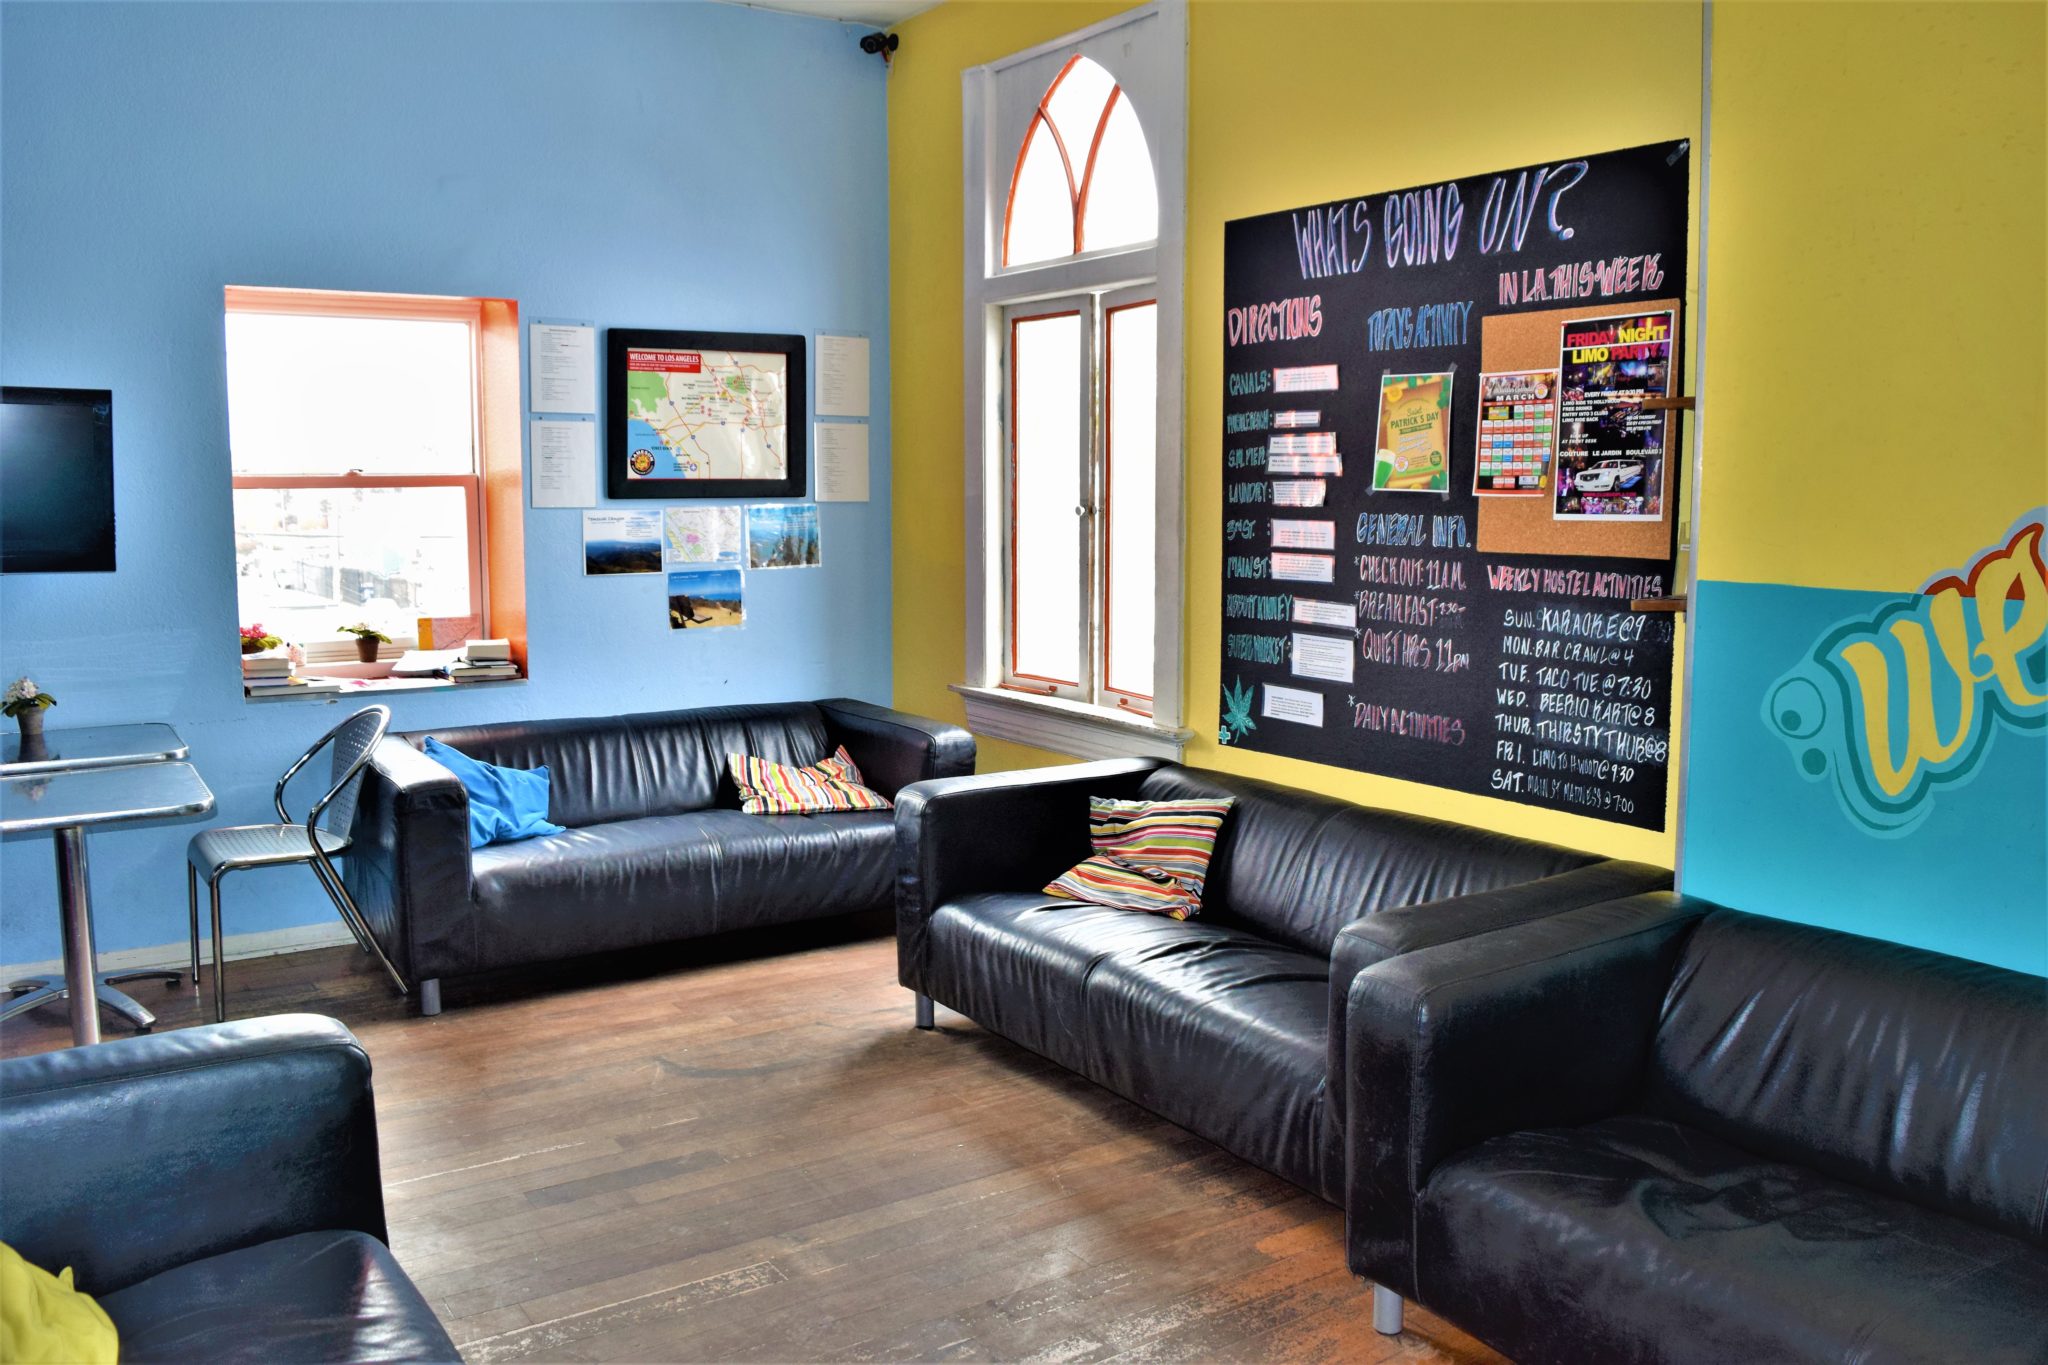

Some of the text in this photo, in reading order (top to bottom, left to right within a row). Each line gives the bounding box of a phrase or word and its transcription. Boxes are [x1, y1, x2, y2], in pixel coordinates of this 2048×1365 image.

[1384, 183, 1464, 268] GOING
[1499, 271, 1518, 305] IN
[1549, 261, 1594, 299] THIS
[1595, 253, 1664, 296] WEEK
[1228, 294, 1322, 347] DIRECTIONS
[1413, 301, 1474, 348] ACTIVITY
[1567, 325, 1667, 347] FRIDAY NIGHT
[630, 353, 700, 363] WELCOME TO LOS ANGELES
[1572, 344, 1660, 364] LIMO PARTY
[1390, 415, 1424, 430] PATRICK'S
[1426, 411, 1440, 423] DAY
[1356, 512, 1426, 546] GENERAL
[1432, 515, 1471, 548] INFO.
[1227, 556, 1253, 578] MAIN
[1360, 555, 1399, 584] CHECK
[1487, 565, 1663, 600] WEEKLY HOSTEL ACTIVITIES
[1503, 609, 1536, 629] SUN.
[1362, 628, 1402, 665] QUIET
[1535, 640, 1560, 659] BAR
[1564, 642, 1608, 664] CRAWL
[1498, 662, 1530, 684] TUE.
[1536, 667, 1570, 689] TACO
[1496, 688, 1528, 707] WED.
[1540, 693, 1589, 718] BEERIO
[1354, 702, 1389, 731] DAILY
[1390, 708, 1466, 746] ACTIVITIES
[1495, 714, 1534, 735] THUR.
[1536, 720, 1602, 749] THIRSTY
[1496, 740, 1525, 764] FRI.
[1532, 748, 1556, 768] LIMO
[1491, 768, 1525, 793] SAT.
